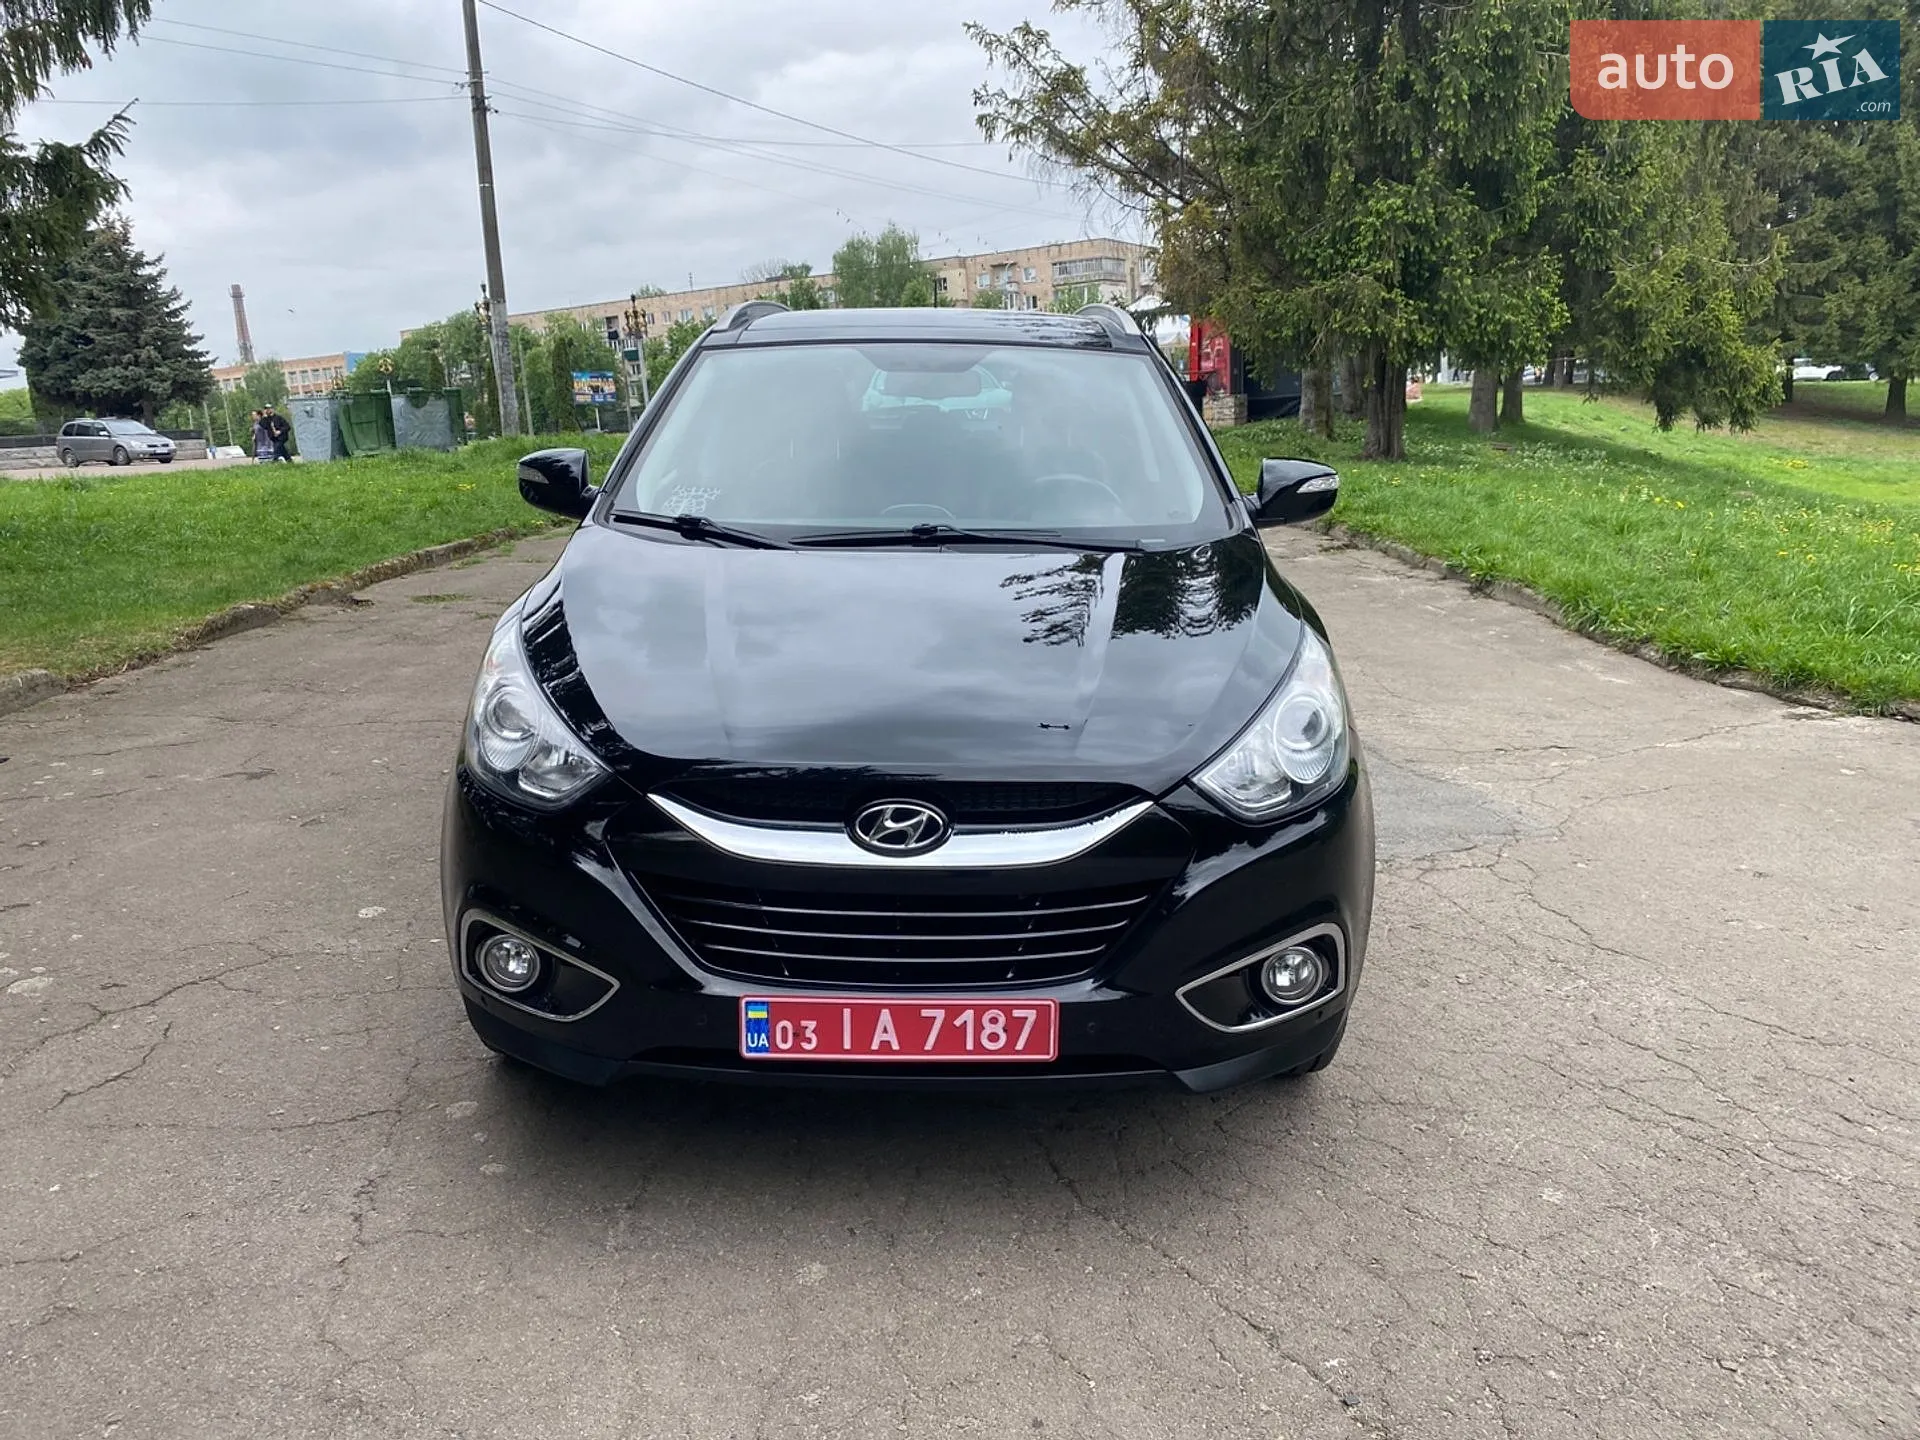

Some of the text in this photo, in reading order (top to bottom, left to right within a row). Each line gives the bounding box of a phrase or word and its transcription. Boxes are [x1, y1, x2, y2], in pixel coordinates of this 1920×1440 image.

[747, 1032, 769, 1048] UA
[775, 1020, 819, 1050] 03
[920, 1008, 1038, 1051] 7187
